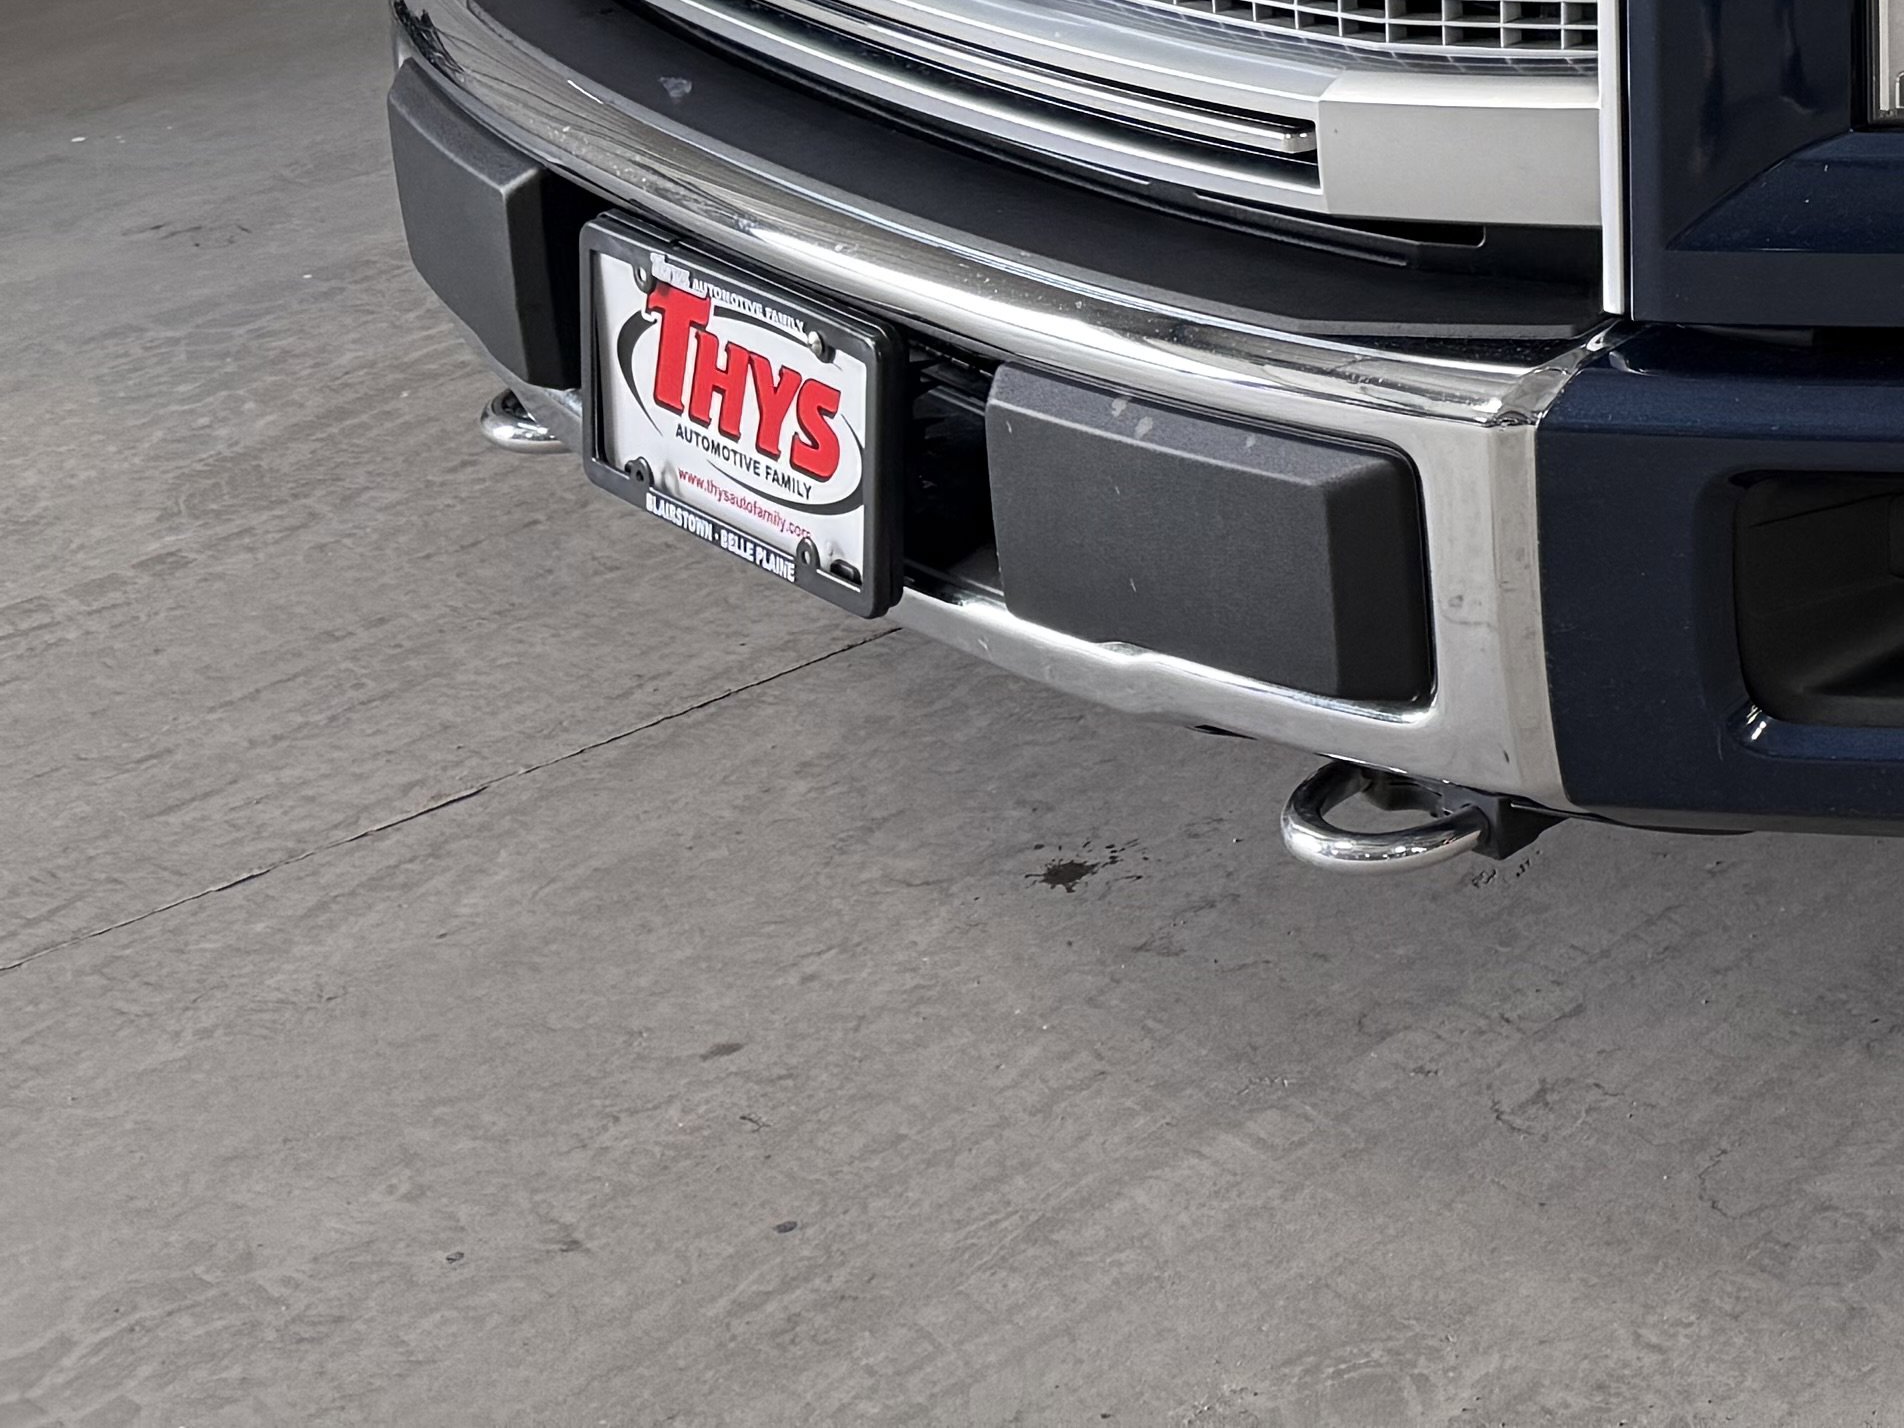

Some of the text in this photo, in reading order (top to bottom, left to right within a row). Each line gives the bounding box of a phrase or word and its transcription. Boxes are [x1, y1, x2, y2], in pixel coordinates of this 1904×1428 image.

[692, 277, 764, 318] AUTOMOTIVE
[764, 305, 808, 334] FAMILY
[646, 284, 842, 483] THYS
[675, 422, 812, 501] AUTOMOTIVE FAMILY
[645, 490, 797, 583] BLAIRSTOWN BELLE PLAINE
